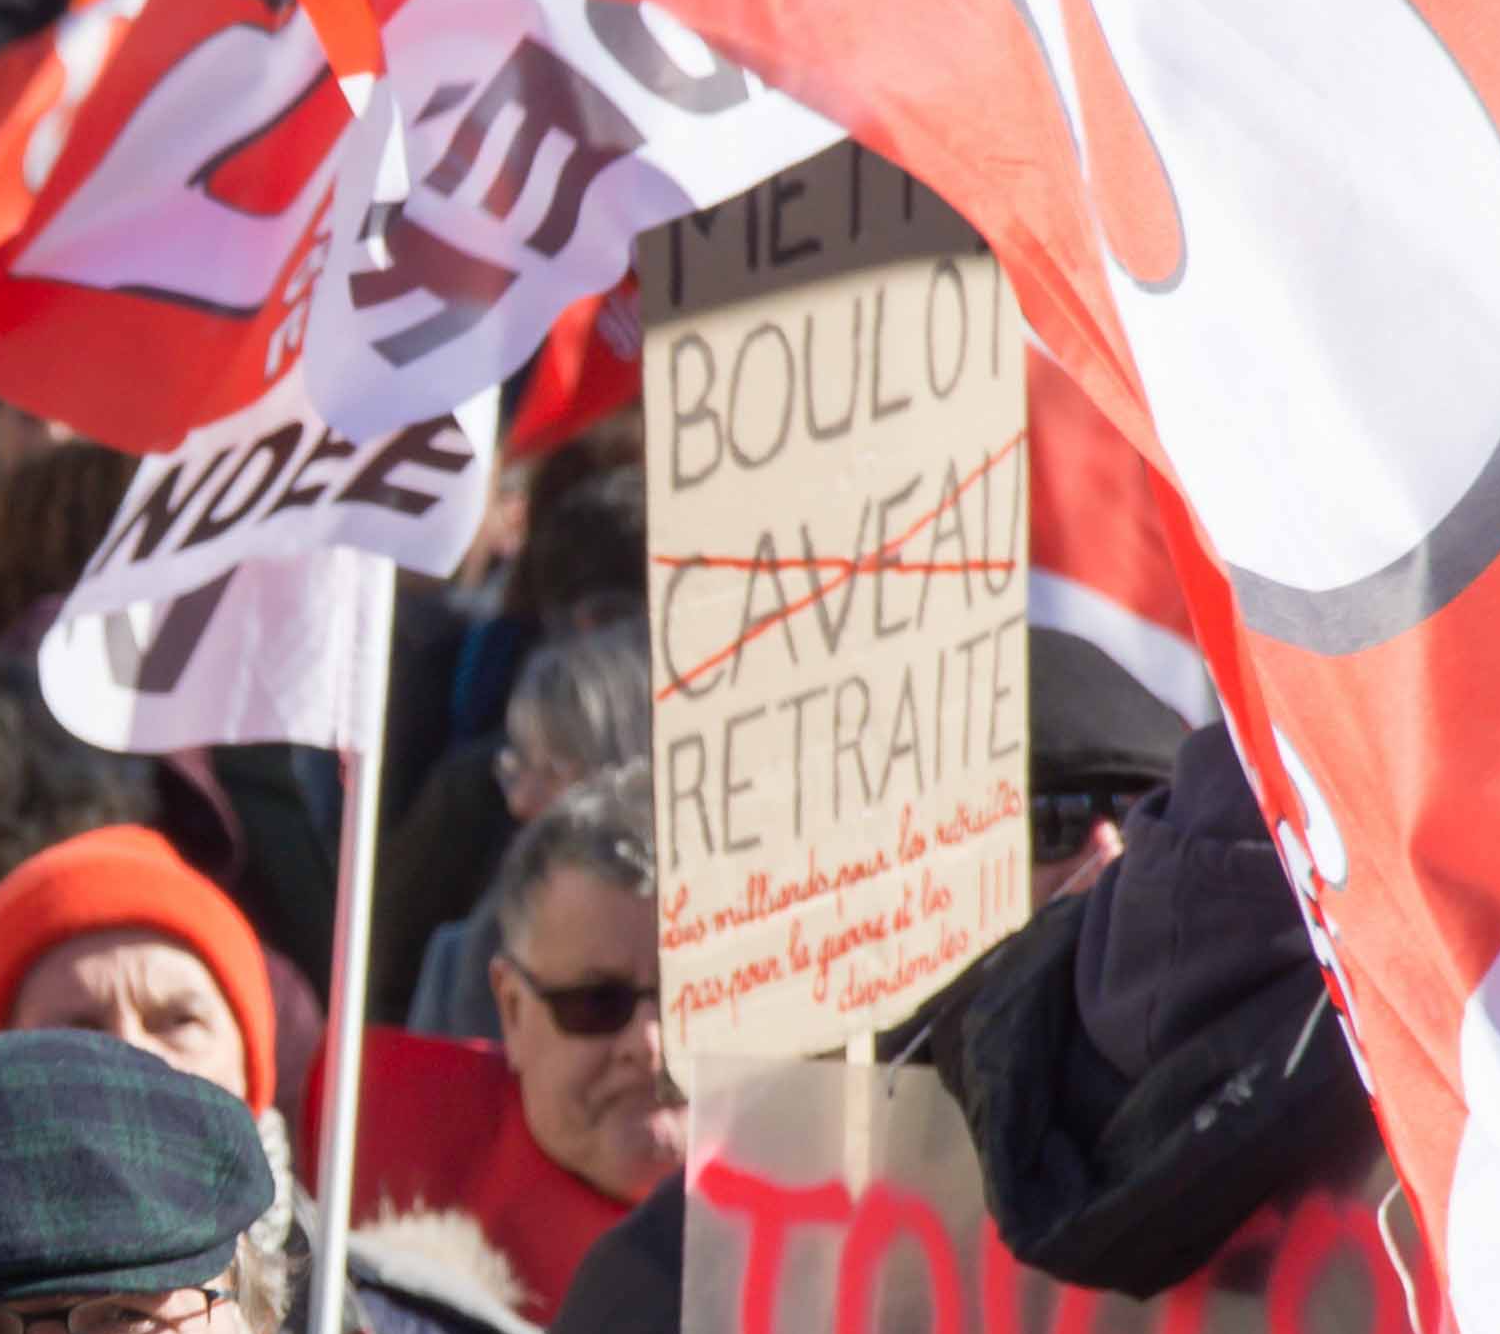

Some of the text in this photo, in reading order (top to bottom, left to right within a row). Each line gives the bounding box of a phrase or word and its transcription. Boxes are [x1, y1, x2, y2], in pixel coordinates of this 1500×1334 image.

[668, 242, 1004, 494] BOULOT
[661, 443, 1021, 699] CAVEAU
[667, 612, 1025, 874] RETRAITE
